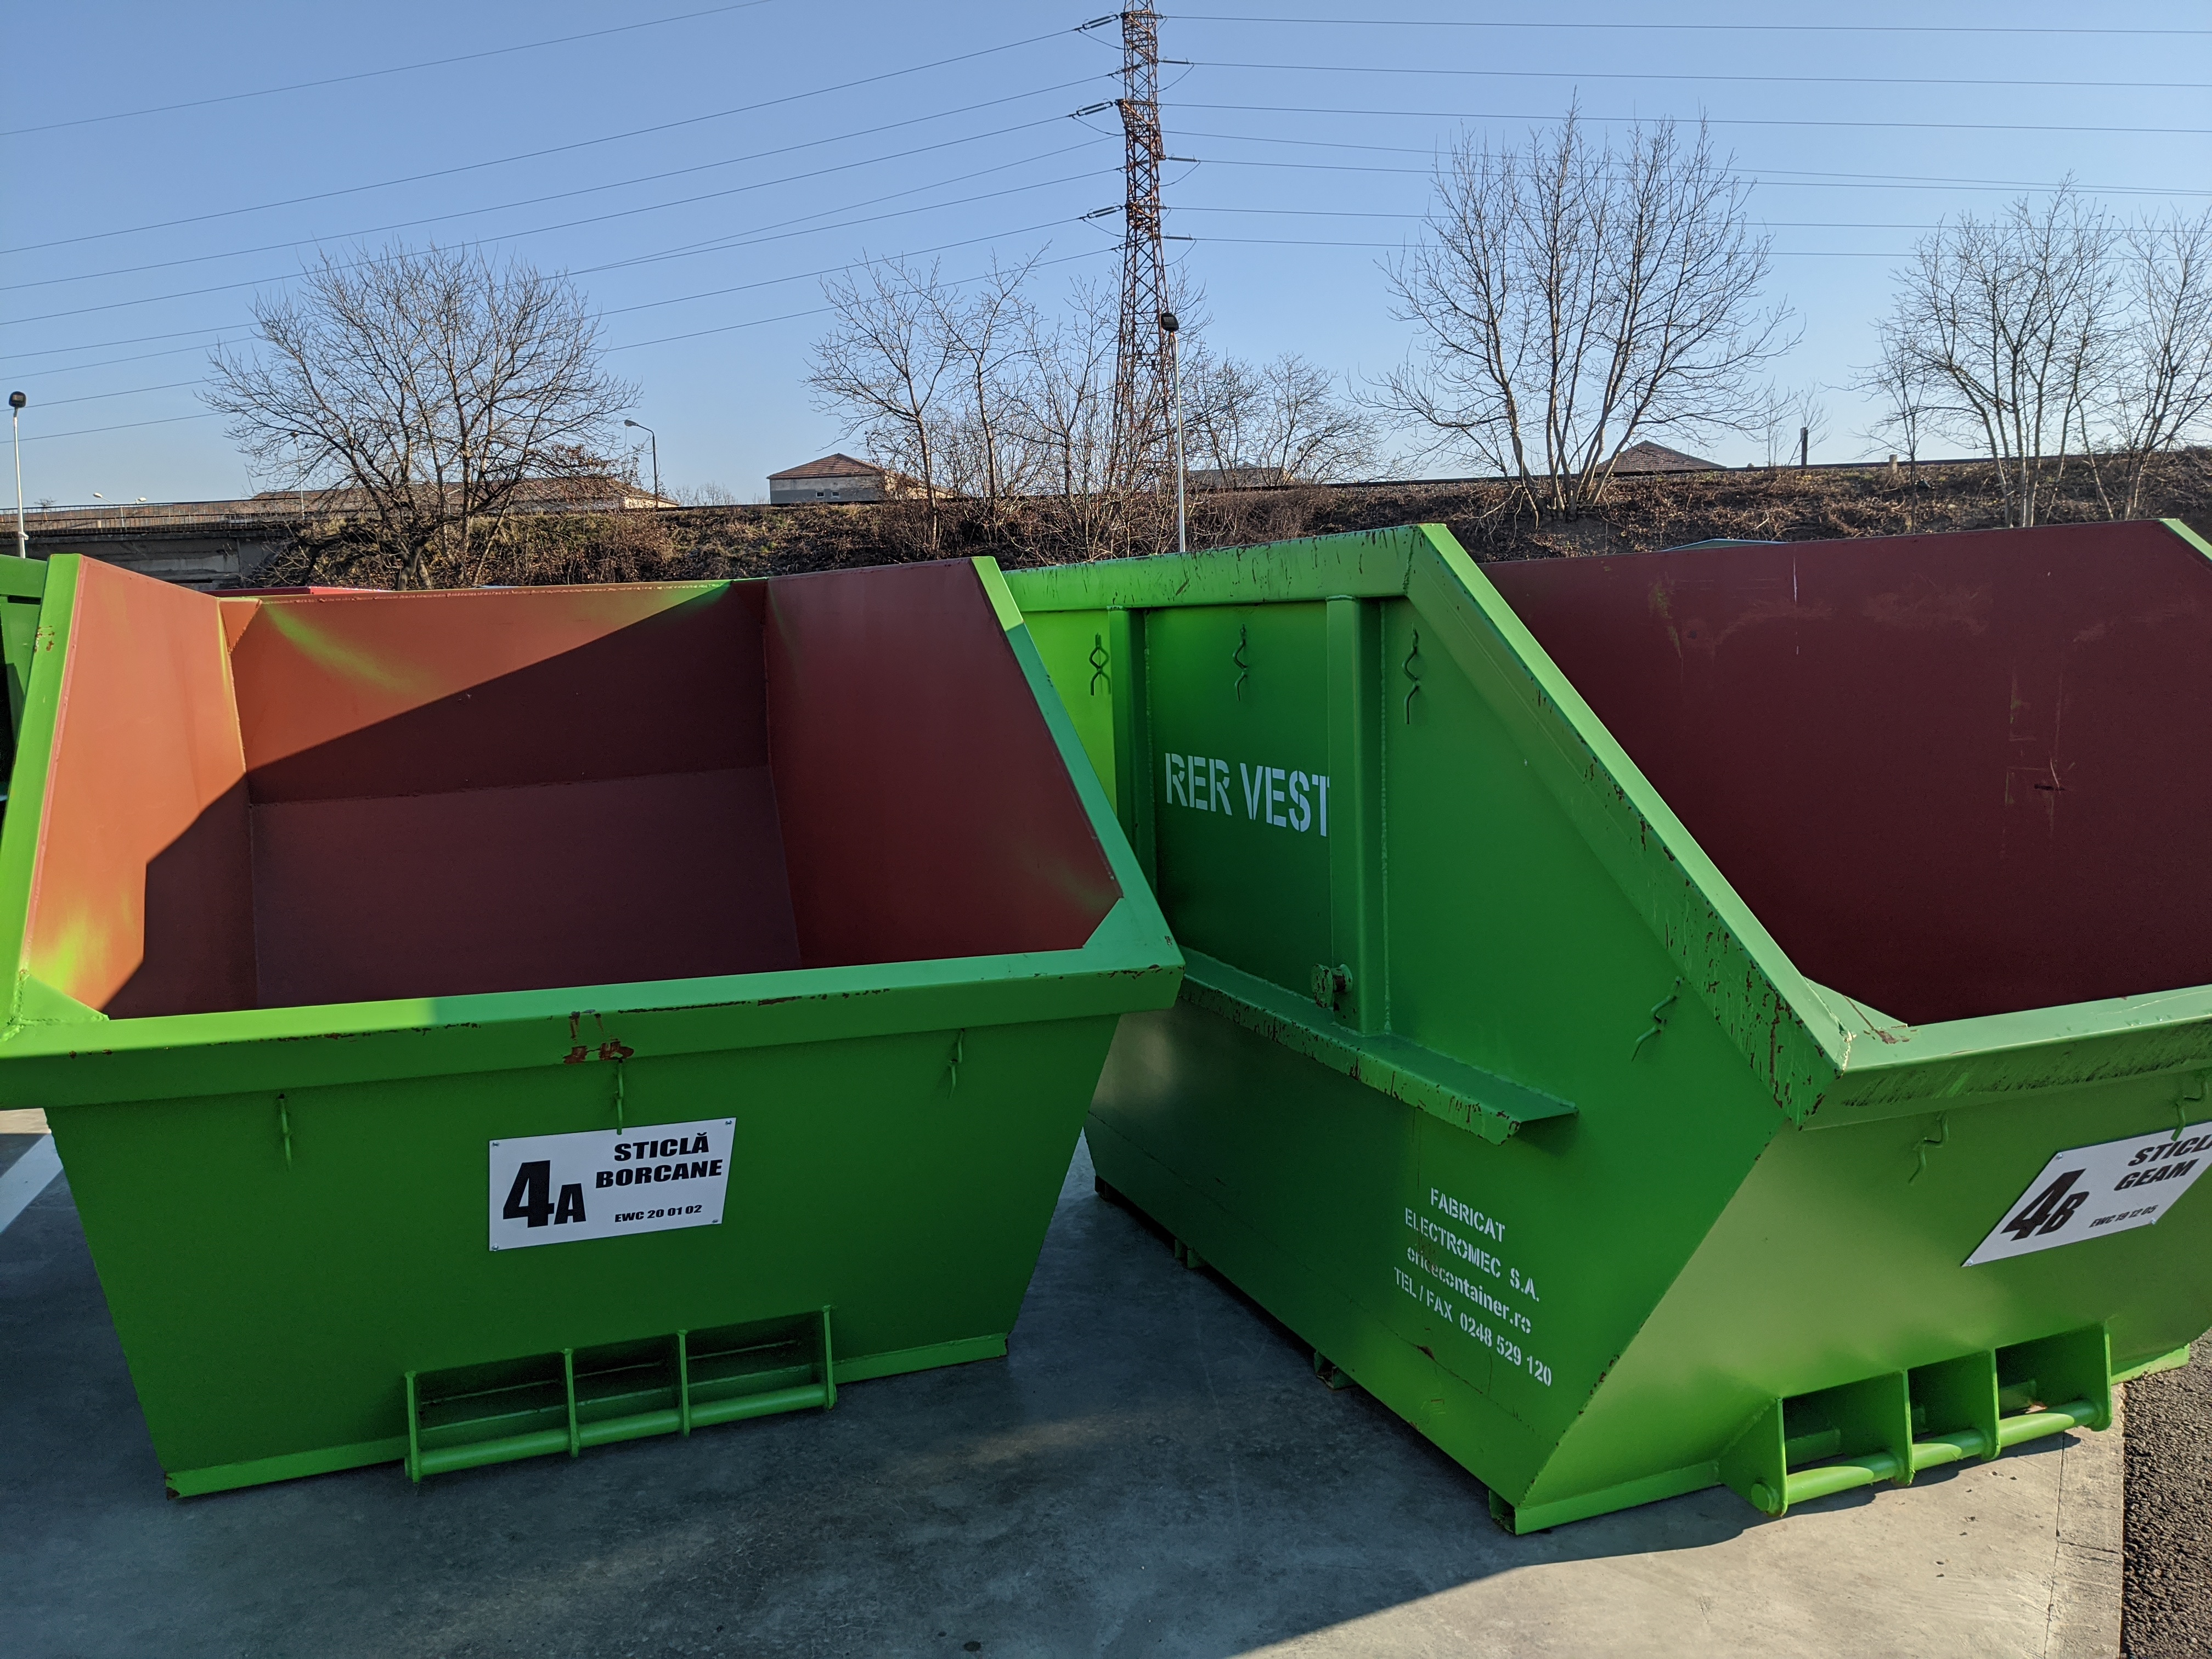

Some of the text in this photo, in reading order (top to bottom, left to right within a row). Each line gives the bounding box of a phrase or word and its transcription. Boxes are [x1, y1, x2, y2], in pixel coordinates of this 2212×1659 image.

[1165, 753, 1330, 837] RER VEST
[614, 1132, 709, 1161] STICLĂ
[2128, 1134, 2212, 1166] STICL
[503, 1160, 586, 1228] 4A
[596, 1159, 723, 1188] BORCANE
[2114, 1158, 2199, 1191] GEAM
[615, 1205, 702, 1222] EWC 20 01 02
[1431, 1187, 1505, 1242] FABRICAT
[2000, 1169, 2090, 1242] 4B
[2089, 1204, 2159, 1228] EWC 19 12 05
[1406, 1207, 1539, 1302] ELECTROMEC S.A.
[1460, 1312, 1492, 1347] 0248
[1497, 1335, 1521, 1365] 529
[1527, 1356, 1551, 1386] 120
